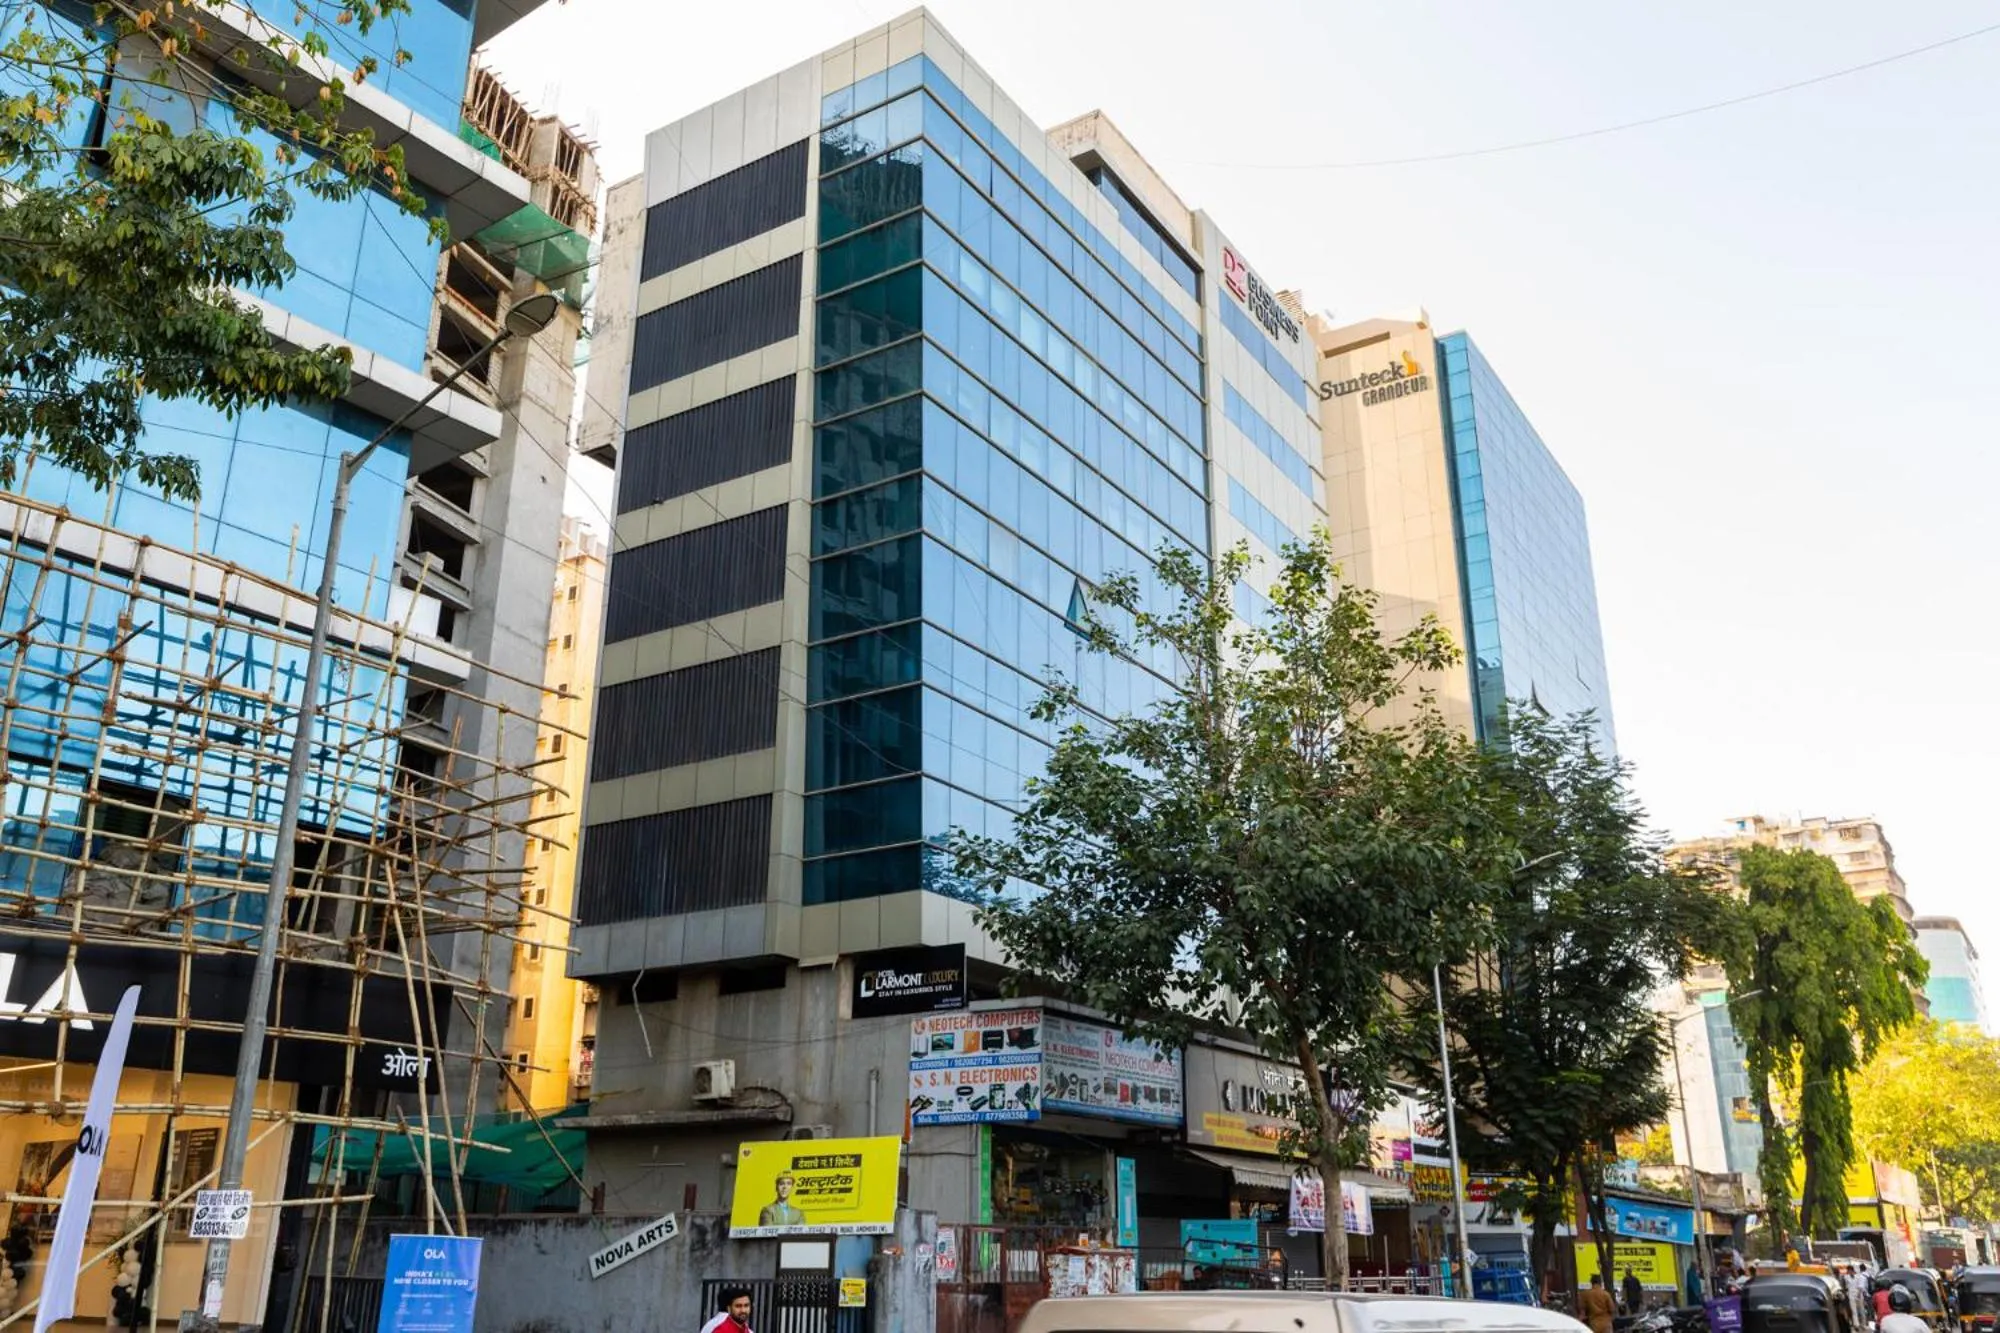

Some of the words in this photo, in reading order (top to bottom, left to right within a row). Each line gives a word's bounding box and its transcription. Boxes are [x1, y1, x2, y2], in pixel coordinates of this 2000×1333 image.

[1247, 271, 1299, 343] BUSINESS
[1248, 292, 1279, 341] POINT
[1319, 361, 1405, 402] Sunteck
[1362, 376, 1428, 407] GRANDEUR
[875, 972, 922, 990] LARMONT
[924, 969, 960, 985] LUXURY
[928, 1014, 973, 1032] NEOTECH
[975, 1008, 1041, 1028] COMPUTERS
[382, 1047, 431, 1078] ओला
[944, 1071, 955, 1085] N.
[960, 1066, 1037, 1084] ELECTRONICS
[76, 1124, 103, 1156] OLA
[424, 1248, 446, 1259] OLA
[595, 1242, 634, 1270] NOVA
[637, 1220, 674, 1249] ARTS
[413, 1278, 440, 1286] CLOSER
